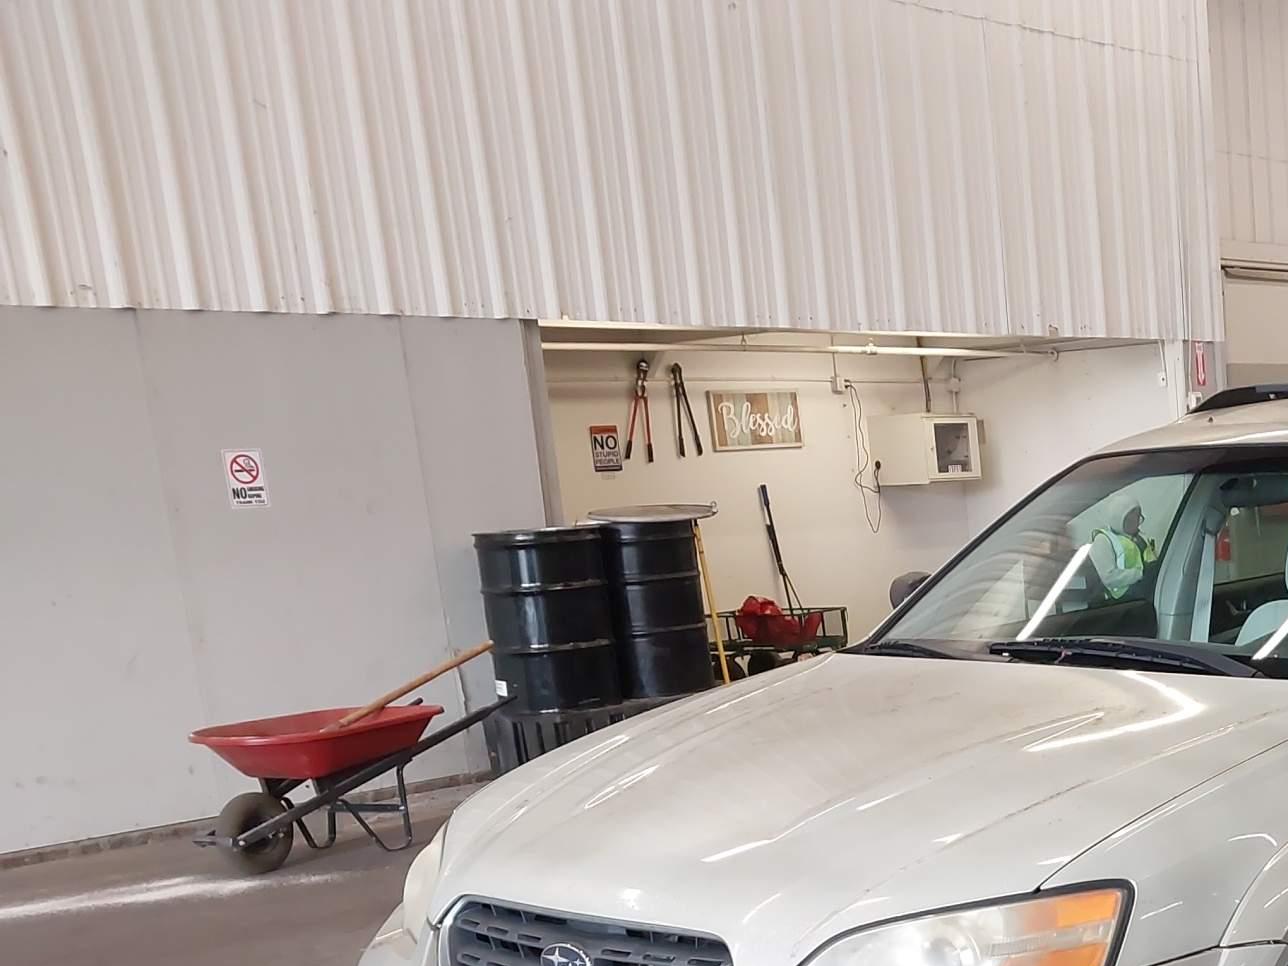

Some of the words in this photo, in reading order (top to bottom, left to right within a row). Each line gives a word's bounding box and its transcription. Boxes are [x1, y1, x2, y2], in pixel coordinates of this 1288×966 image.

[717, 400, 799, 438] Blessed
[593, 435, 617, 451] NO
[232, 487, 247, 500] NO
